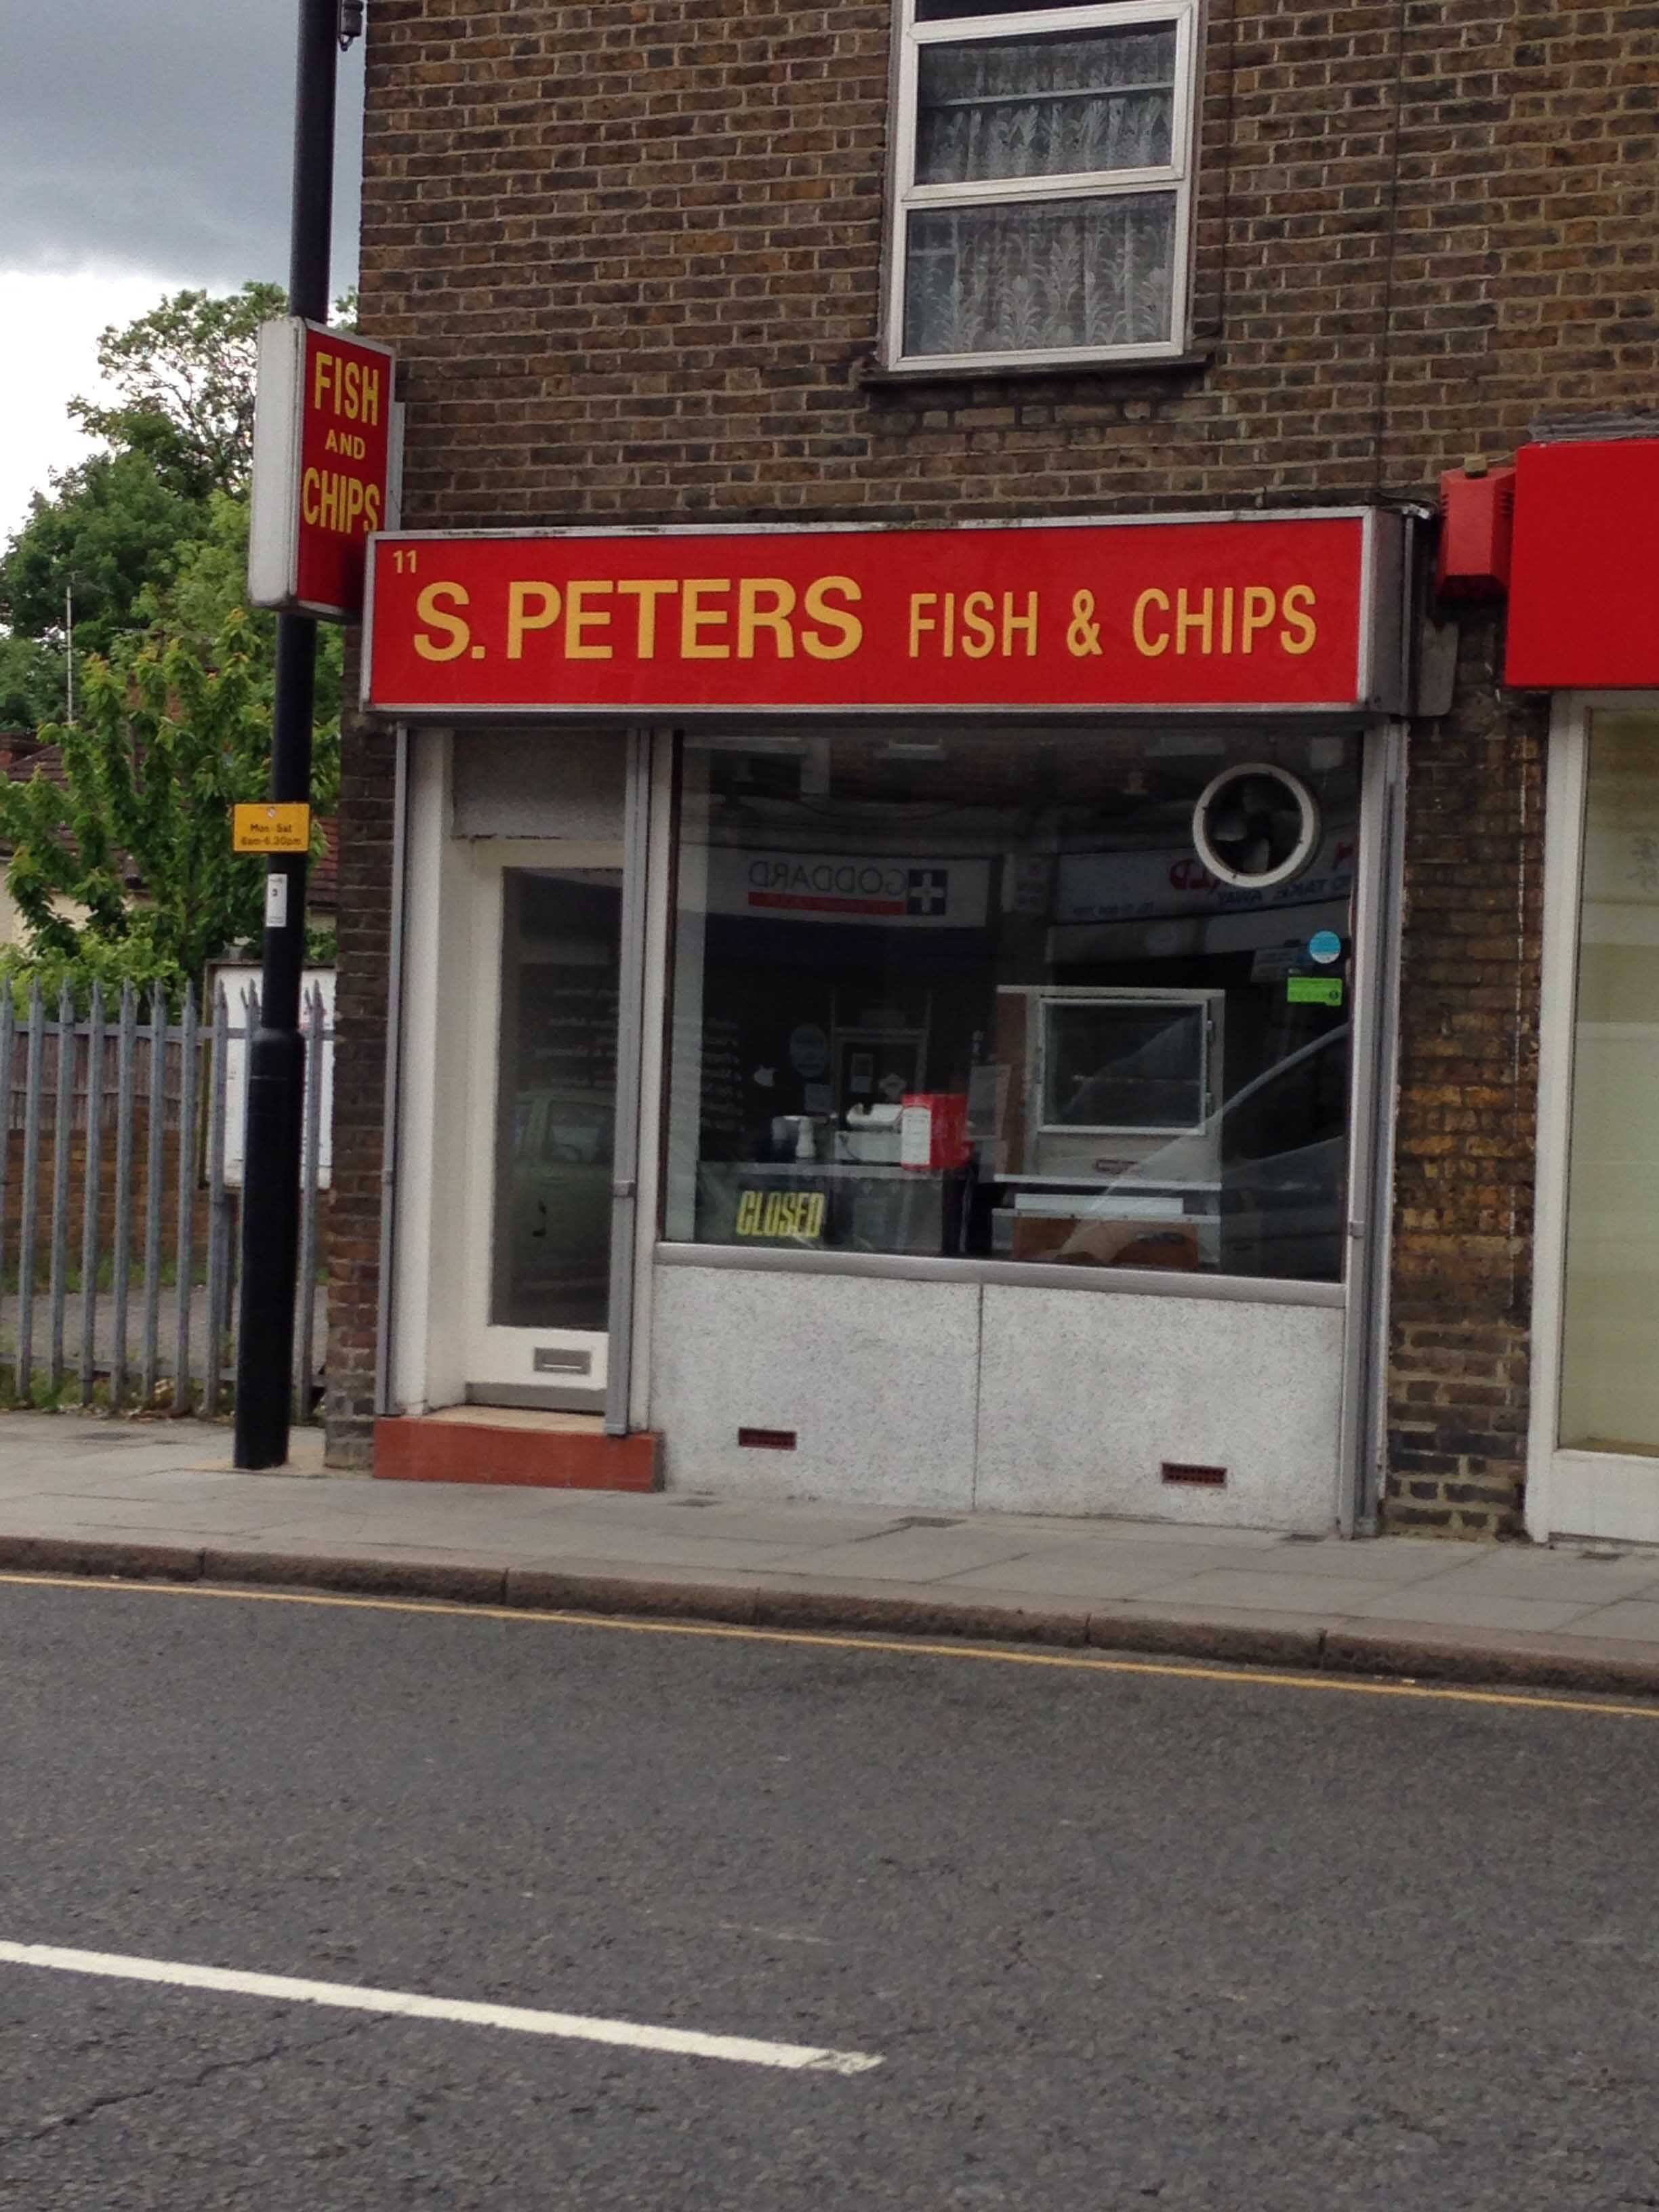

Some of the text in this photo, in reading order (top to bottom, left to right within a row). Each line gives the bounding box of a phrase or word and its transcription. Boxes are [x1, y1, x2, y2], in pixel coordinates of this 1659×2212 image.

[314, 351, 380, 426] FISH
[325, 429, 366, 460] AND
[302, 466, 380, 534] CHIPS
[393, 550, 417, 574] 11
[413, 576, 1317, 662] S. PETERS FISH & CHIPS
[736, 1190, 825, 1237] CLOSED
